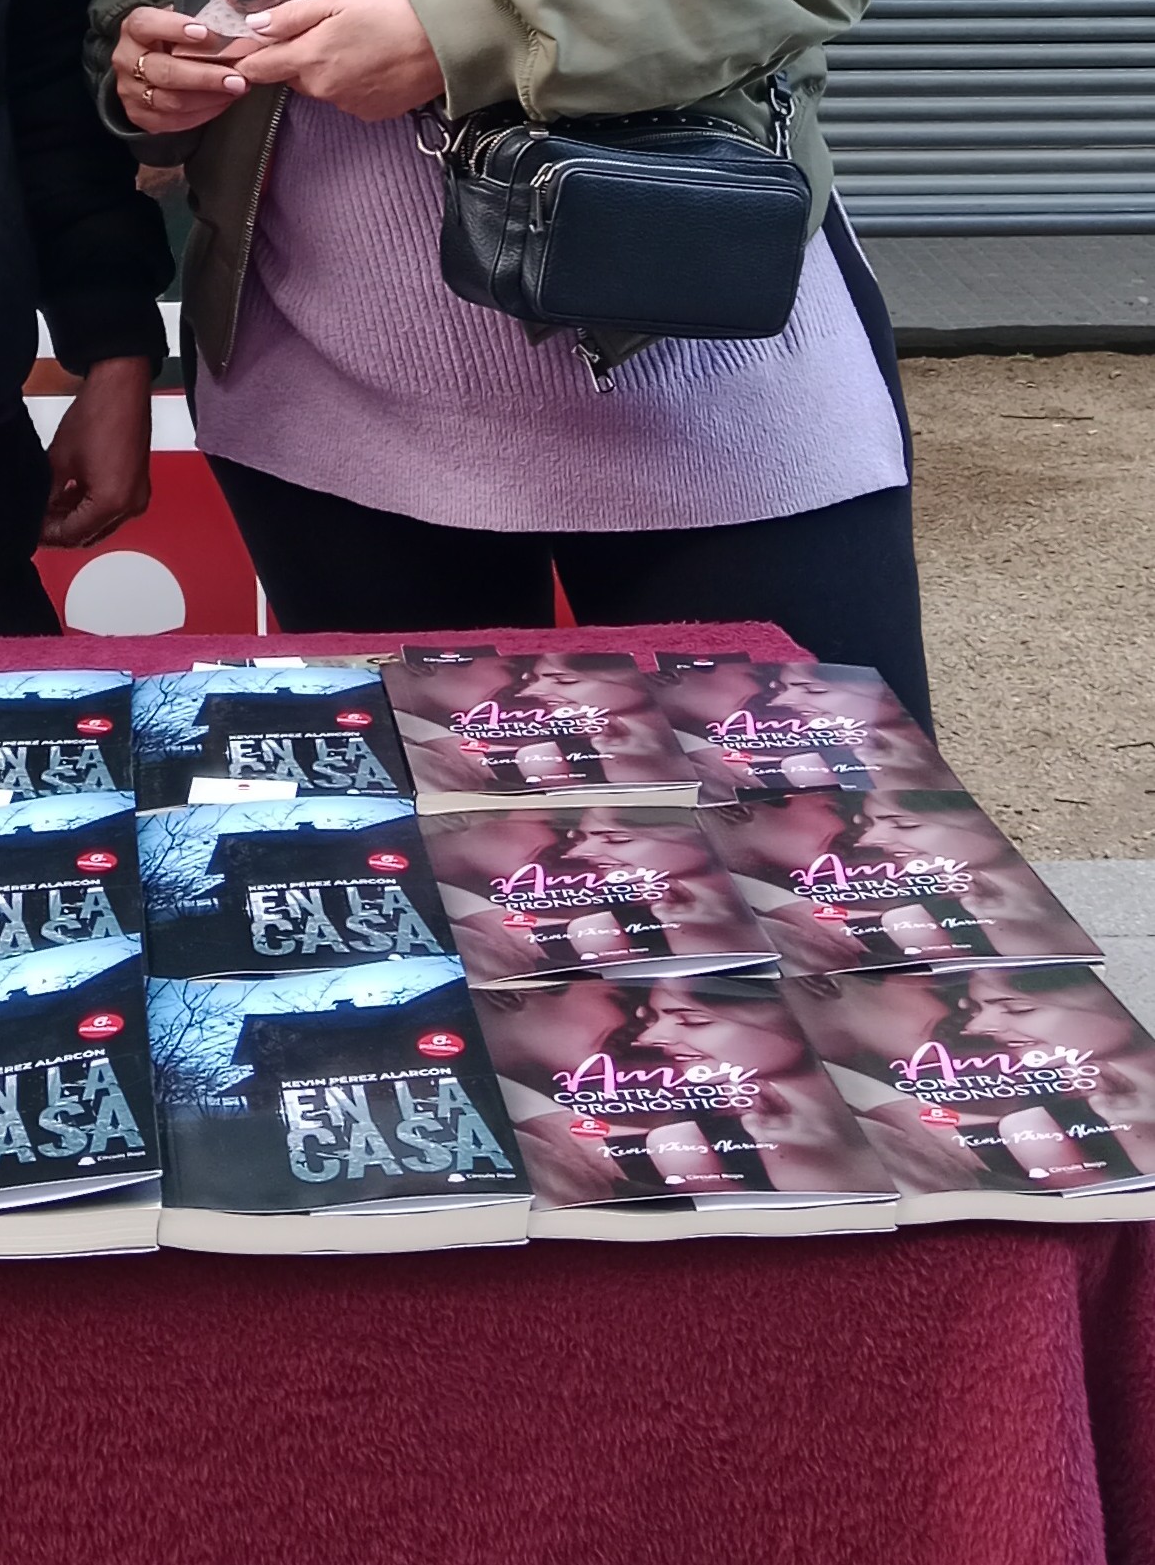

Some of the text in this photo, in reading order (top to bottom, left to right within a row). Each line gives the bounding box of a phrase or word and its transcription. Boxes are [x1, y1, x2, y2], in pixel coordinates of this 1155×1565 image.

[450, 701, 610, 728] Amor
[706, 710, 865, 736] Amor
[49, 745, 103, 770] LA
[229, 737, 369, 763] EN LA
[490, 863, 670, 896] Amor
[790, 854, 969, 888] Amor
[794, 873, 973, 895] CONTRA TODO
[49, 887, 111, 921] LA
[249, 886, 413, 921] EN LA
[490, 882, 670, 903] CONTRA TODO
[505, 891, 664, 912] PRONÓSTICO
[811, 883, 969, 904] PRONÓSTICO
[251, 912, 445, 956] CASA
[34, 1048, 106, 1068] ALARCÓN
[889, 1041, 1095, 1088] Amor
[47, 1057, 119, 1107] LA
[281, 1067, 452, 1089] KEVIN PÉREZ ALARCÓN
[553, 1053, 758, 1097] Amor
[895, 1065, 1101, 1092] CONTRA TODO
[281, 1077, 472, 1131] EN LA
[554, 1083, 761, 1105] CONTRA TODO
[915, 1078, 1097, 1104] PRONÓSTICO
[572, 1095, 754, 1117] PRONÓSTICO
[287, 1112, 514, 1183] CASA
